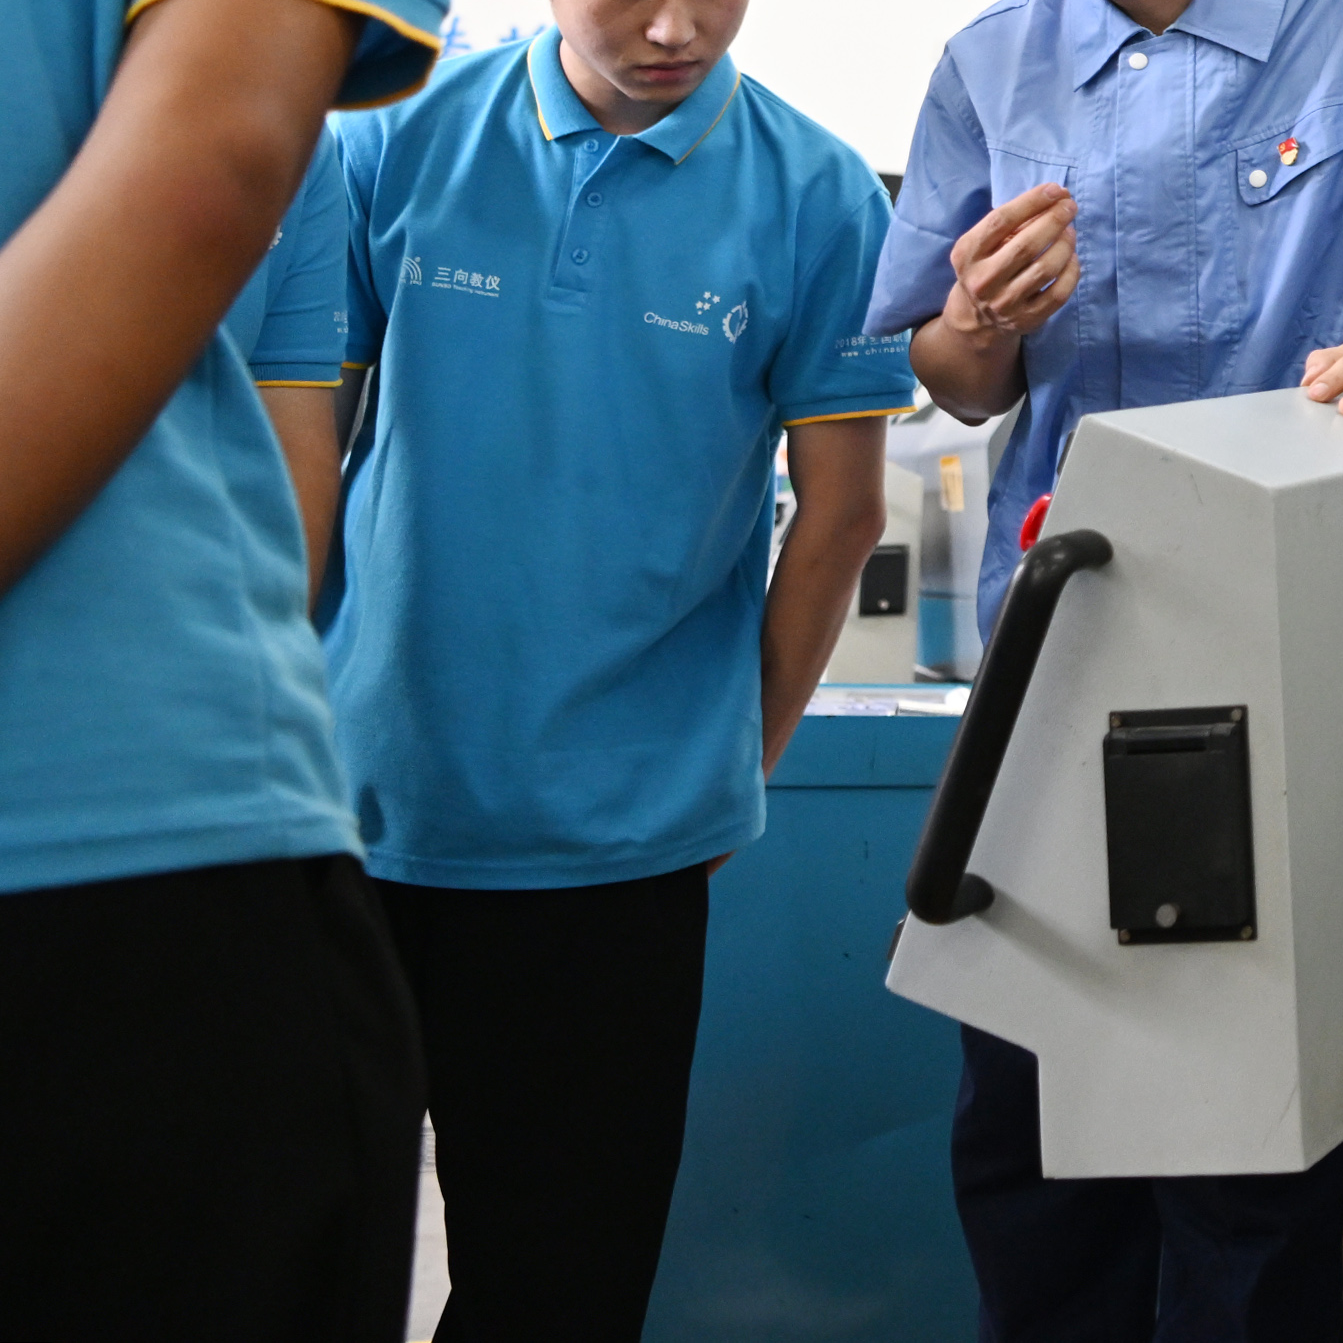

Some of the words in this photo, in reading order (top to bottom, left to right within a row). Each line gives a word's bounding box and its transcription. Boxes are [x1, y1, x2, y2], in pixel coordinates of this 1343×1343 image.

[434, 267, 500, 291] 三向教仪
[643, 311, 710, 336] ChinaSkills
